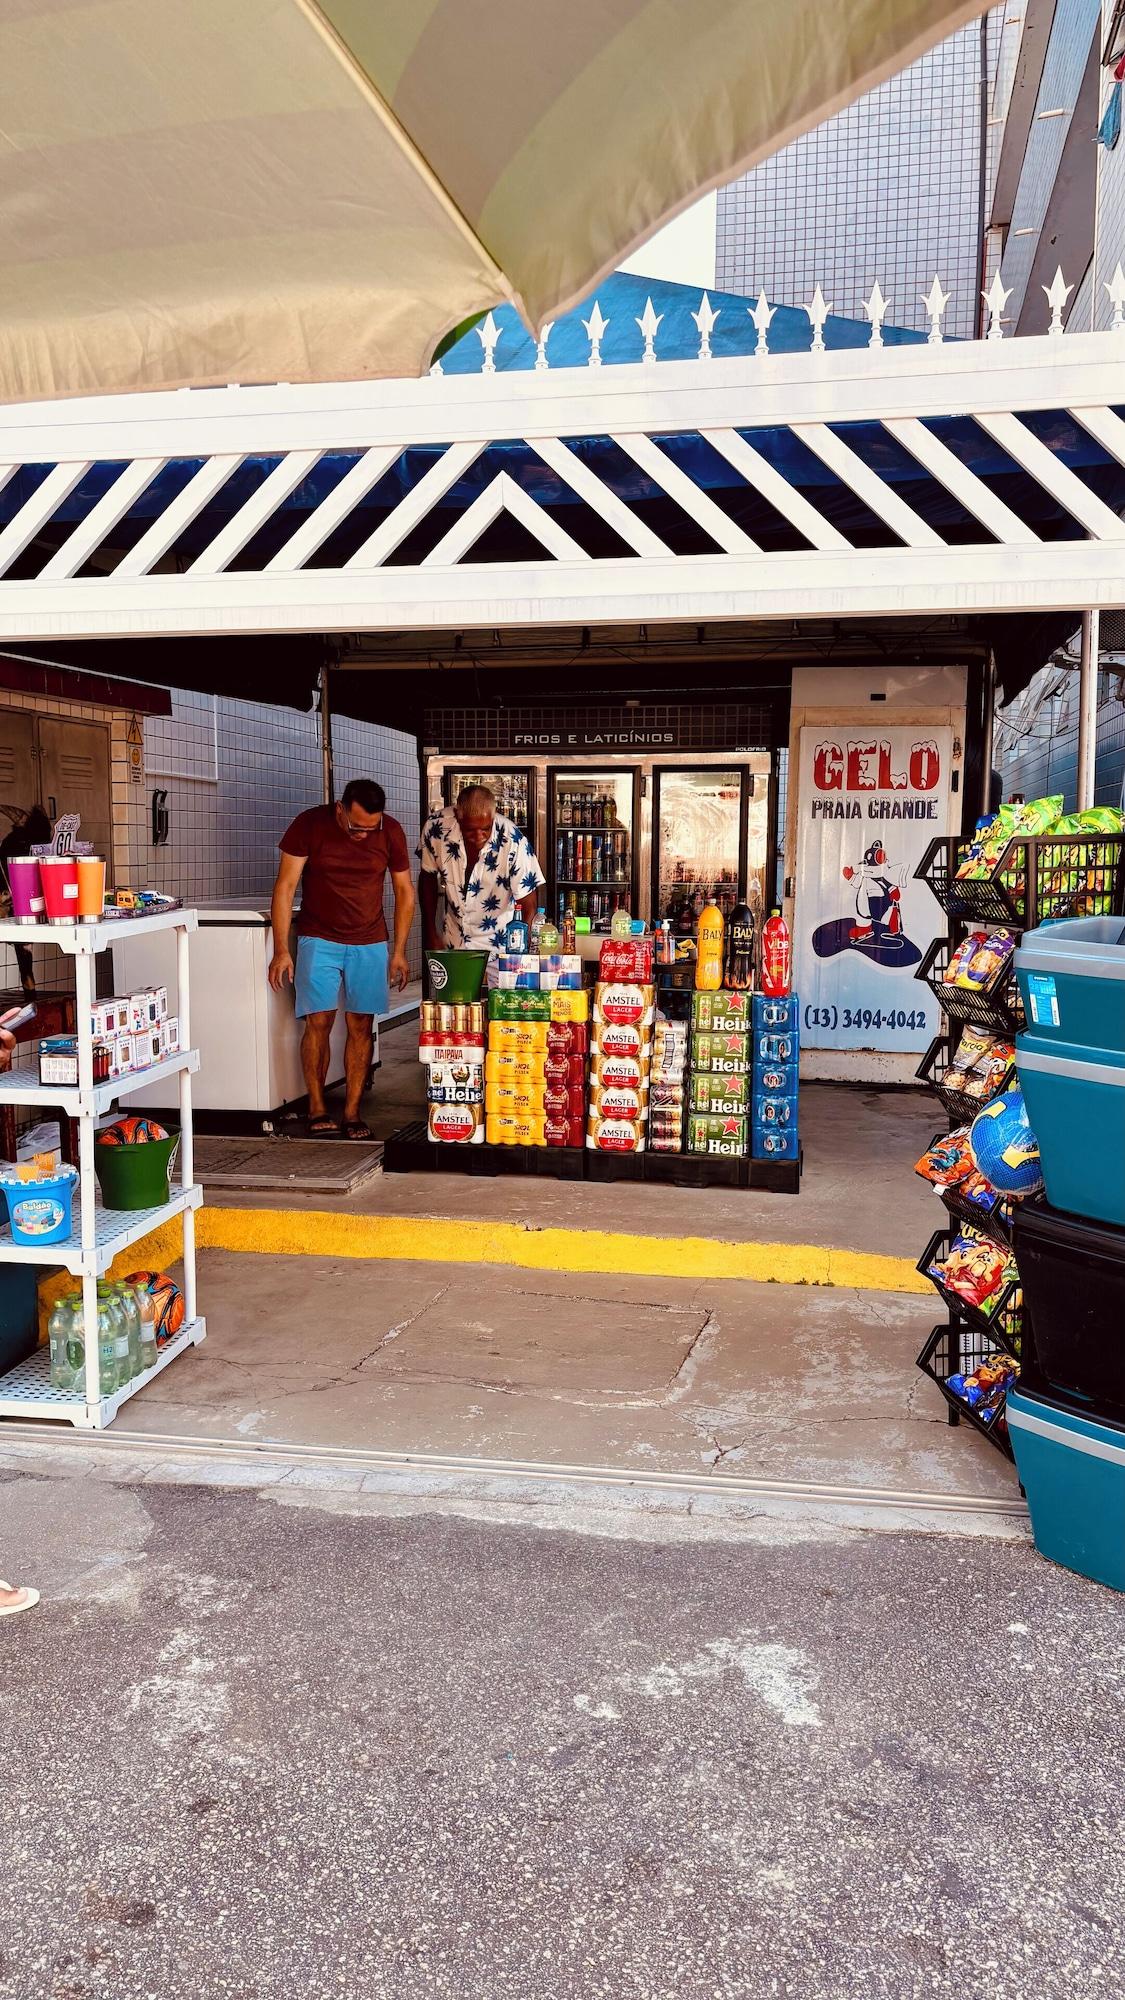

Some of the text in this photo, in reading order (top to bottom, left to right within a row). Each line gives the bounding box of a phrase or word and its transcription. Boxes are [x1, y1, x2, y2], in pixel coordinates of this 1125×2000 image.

[515, 730, 674, 745] FRIOS E LATICÍNIOS
[812, 739, 940, 791] GELO
[811, 796, 938, 820] PRAIA GRANDE
[702, 928, 723, 941] BALY
[733, 926, 754, 940] BALY
[605, 996, 640, 1006] AMSTEL
[804, 1005, 926, 1031] (13) 3494-4042
[605, 1034, 636, 1044] AMSTEL
[434, 1048, 463, 1060] ITAIPAVA
[605, 1066, 636, 1076] AMSTEL
[604, 1097, 635, 1107] AMSTEL
[436, 1115, 470, 1124] AMSTEL
[601, 1129, 632, 1138] AMSTEL
